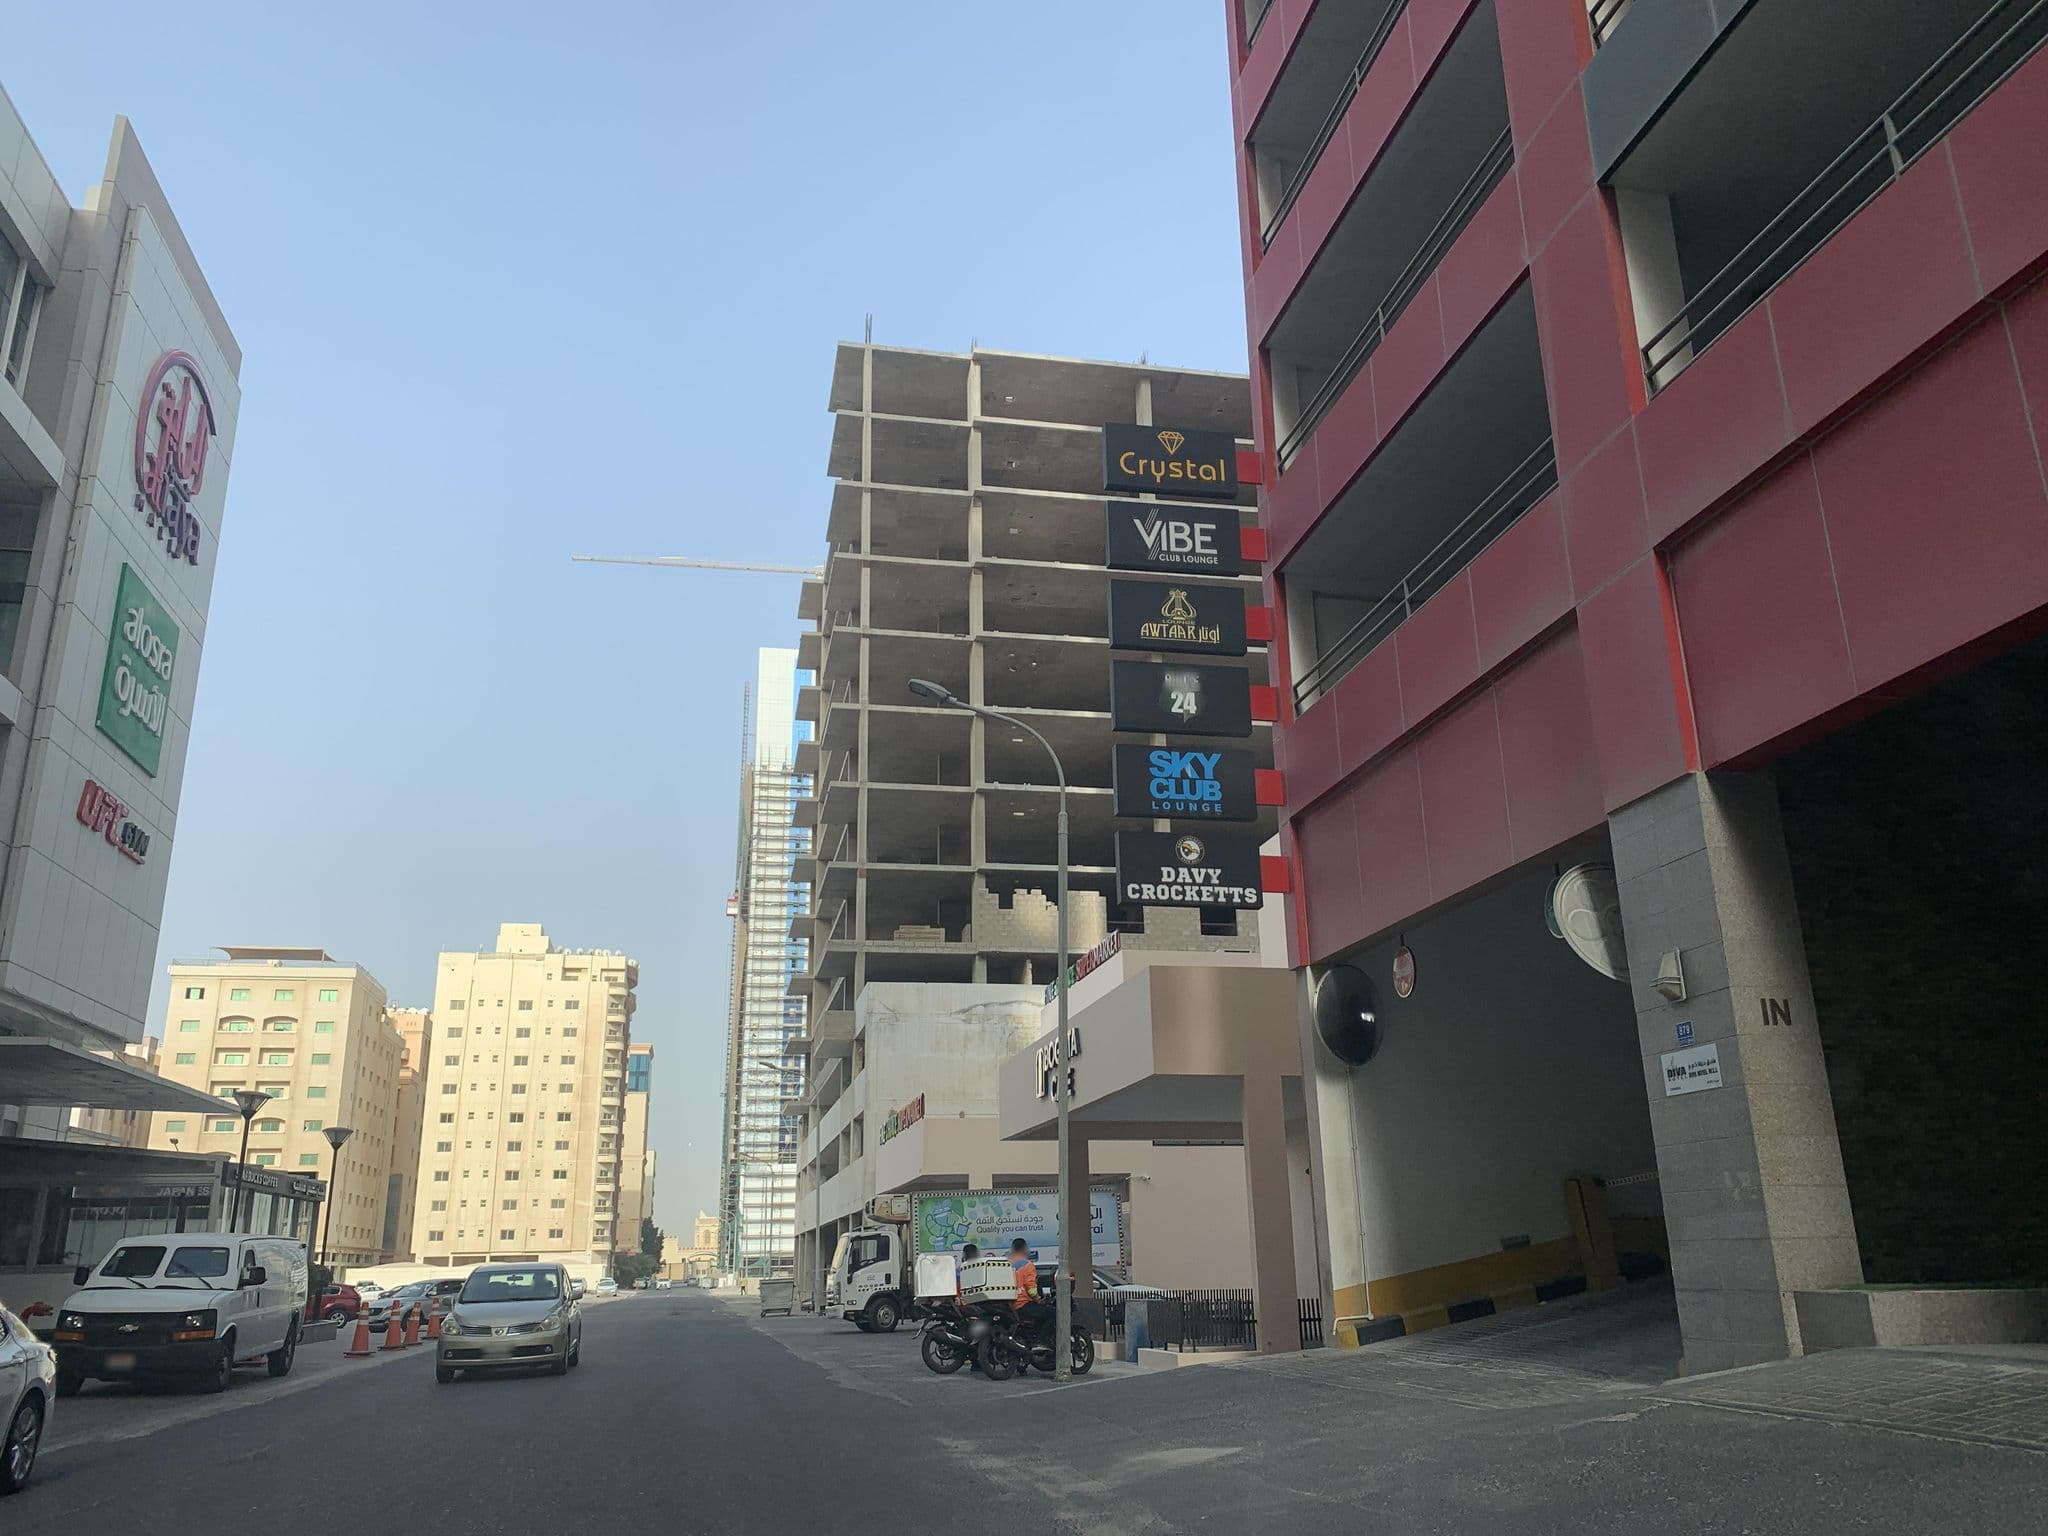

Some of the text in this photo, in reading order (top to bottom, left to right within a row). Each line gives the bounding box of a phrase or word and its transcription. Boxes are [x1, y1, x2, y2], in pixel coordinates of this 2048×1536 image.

[1119, 450, 1226, 483] Crystal
[1133, 515, 1218, 557] VIBE
[1158, 552, 1219, 565] CLUB LOUNGE
[1140, 622, 1197, 640] AWTAAR
[123, 607, 173, 681] alosra
[1170, 691, 1197, 714] 24
[1148, 750, 1222, 780] SKY
[1149, 777, 1223, 801] CLUB
[1151, 801, 1223, 813] LOUNGE
[1160, 866, 1222, 884] DAVY
[1127, 883, 1258, 903] CROCKETTS
[1760, 998, 1792, 1026] IN
[1667, 1066, 1687, 1079] DIVA
[976, 1225, 1000, 1234] Quality
[1001, 1226, 1014, 1234] you
[1029, 1223, 1044, 1231] trust
